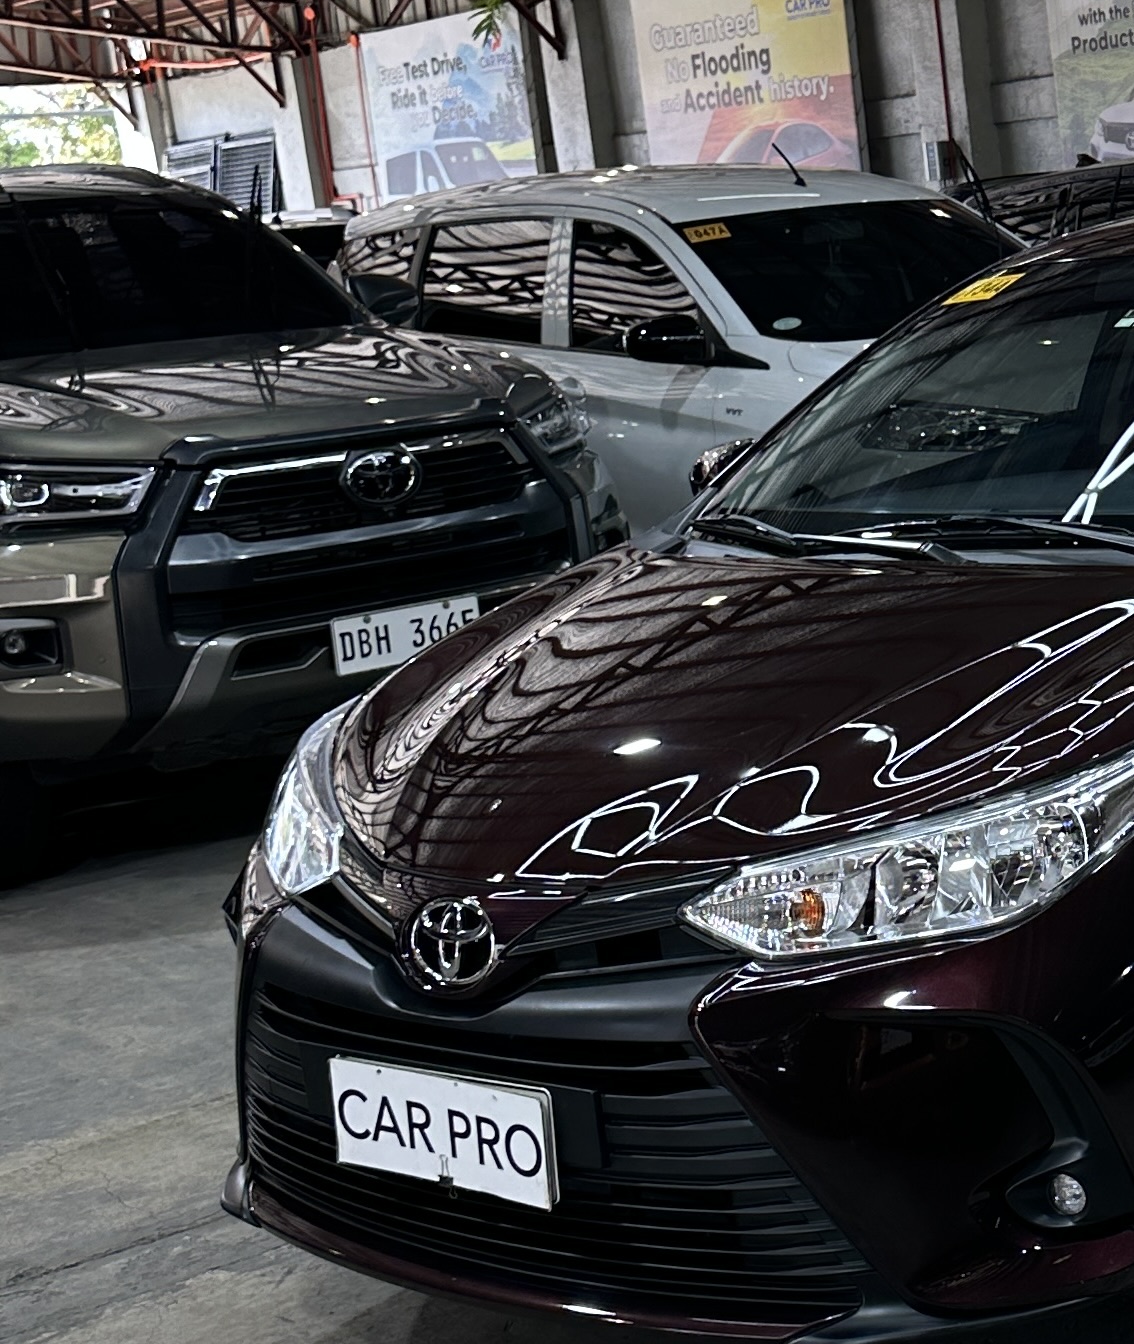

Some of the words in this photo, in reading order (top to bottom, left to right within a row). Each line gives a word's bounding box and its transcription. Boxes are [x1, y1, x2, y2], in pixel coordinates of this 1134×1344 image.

[651, 4, 760, 51] Guaranteed
[1078, 7, 1107, 27] with
[1109, 5, 1131, 20] the
[403, 59, 430, 82] Test
[431, 52, 467, 76] Drive,
[665, 57, 690, 84] No
[691, 43, 771, 79] Flooding
[391, 89, 417, 110] Ride
[418, 84, 428, 105] it
[684, 79, 764, 114] Accident
[768, 73, 835, 102] history.
[339, 624, 391, 662] DBH
[338, 1088, 436, 1154] CAR
[447, 1108, 543, 1178] PRO
